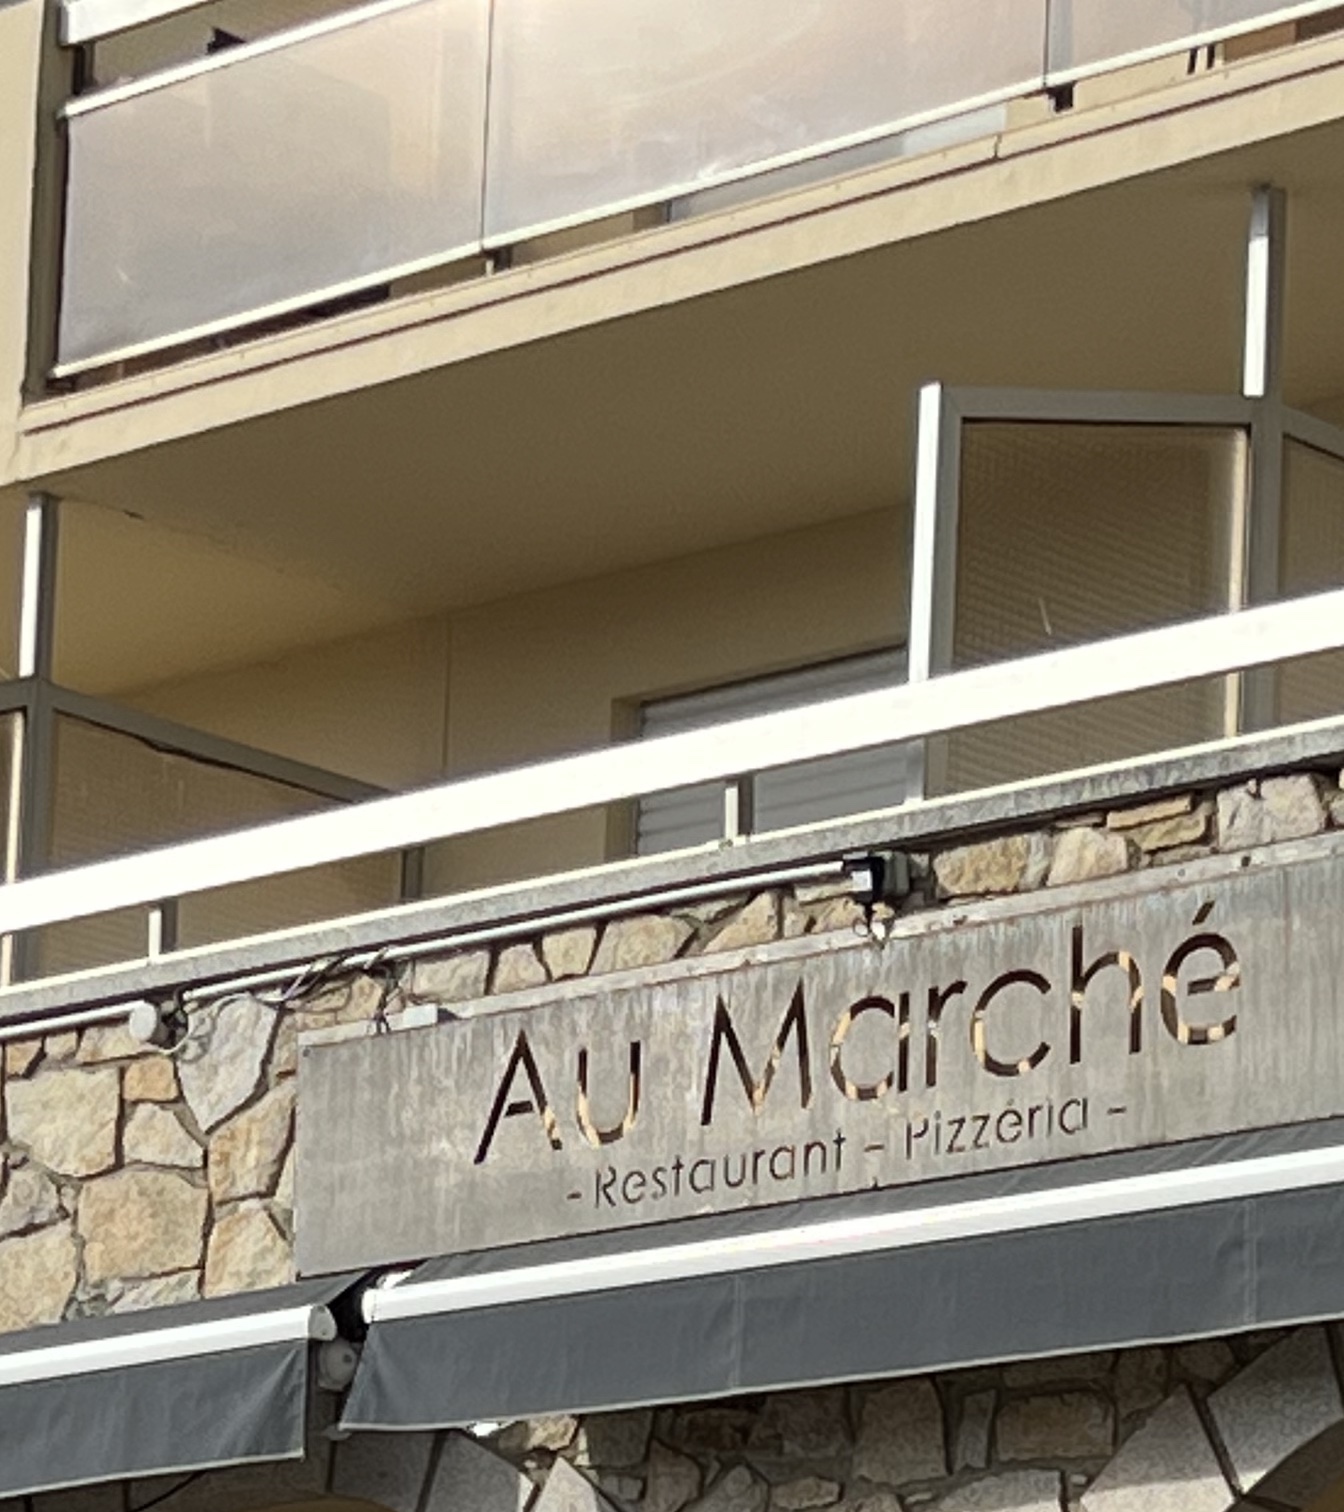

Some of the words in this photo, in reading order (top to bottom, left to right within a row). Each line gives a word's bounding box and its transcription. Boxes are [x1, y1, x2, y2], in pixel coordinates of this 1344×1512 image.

[473, 1029, 642, 1164] Au
[700, 900, 1242, 1127] Marché
[594, 1127, 847, 1209] Restaurant
